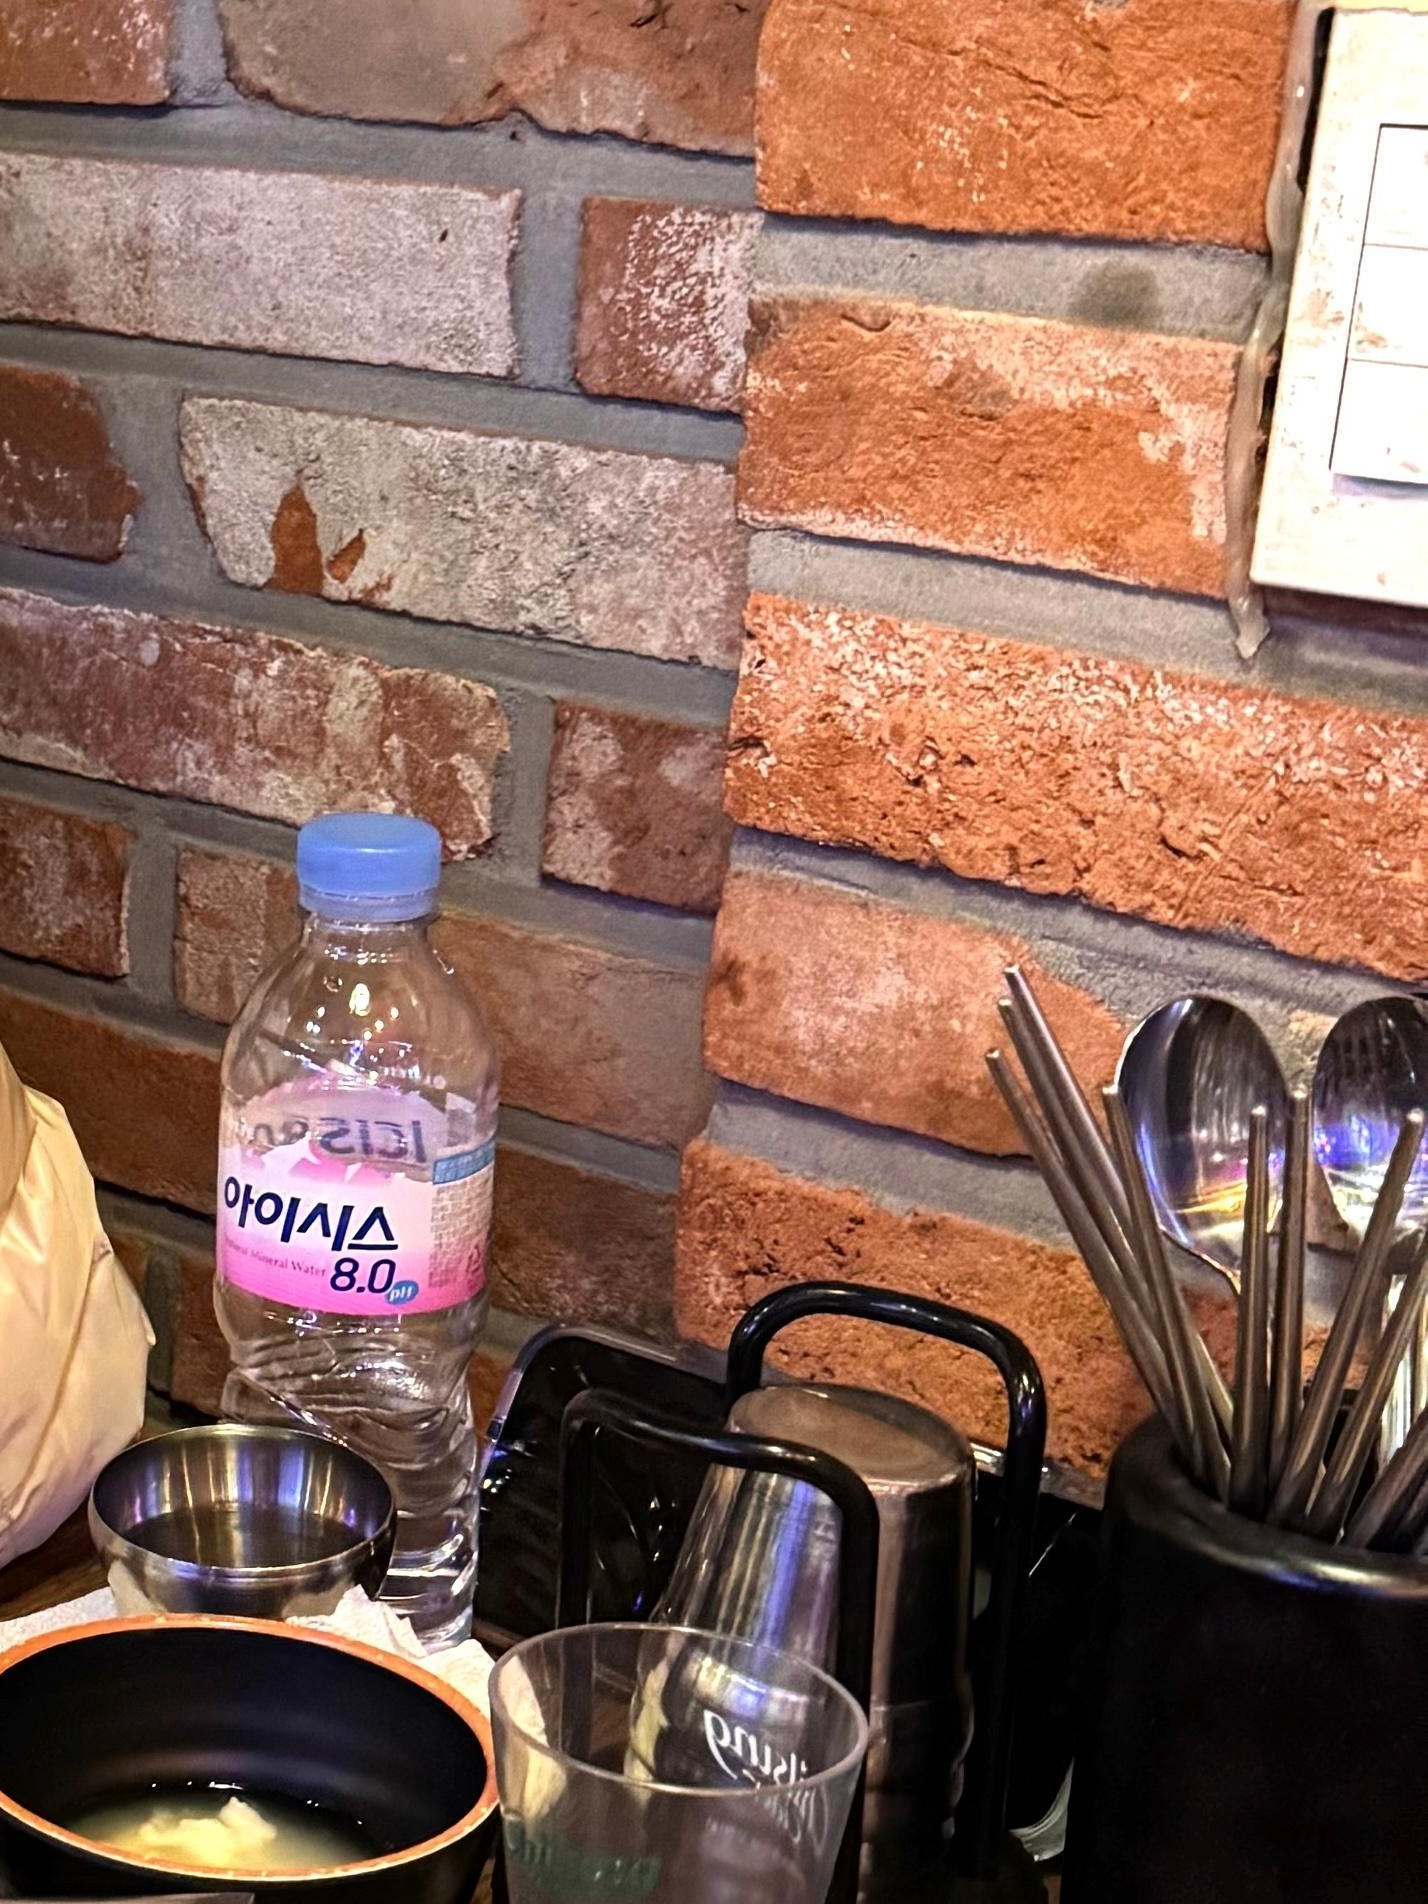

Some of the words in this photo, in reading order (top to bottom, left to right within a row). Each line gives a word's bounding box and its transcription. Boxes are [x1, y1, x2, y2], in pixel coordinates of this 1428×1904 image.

[223, 1175, 399, 1252] 아이시스
[329, 1256, 397, 1294] 8.0
[388, 1284, 413, 1303] pH
